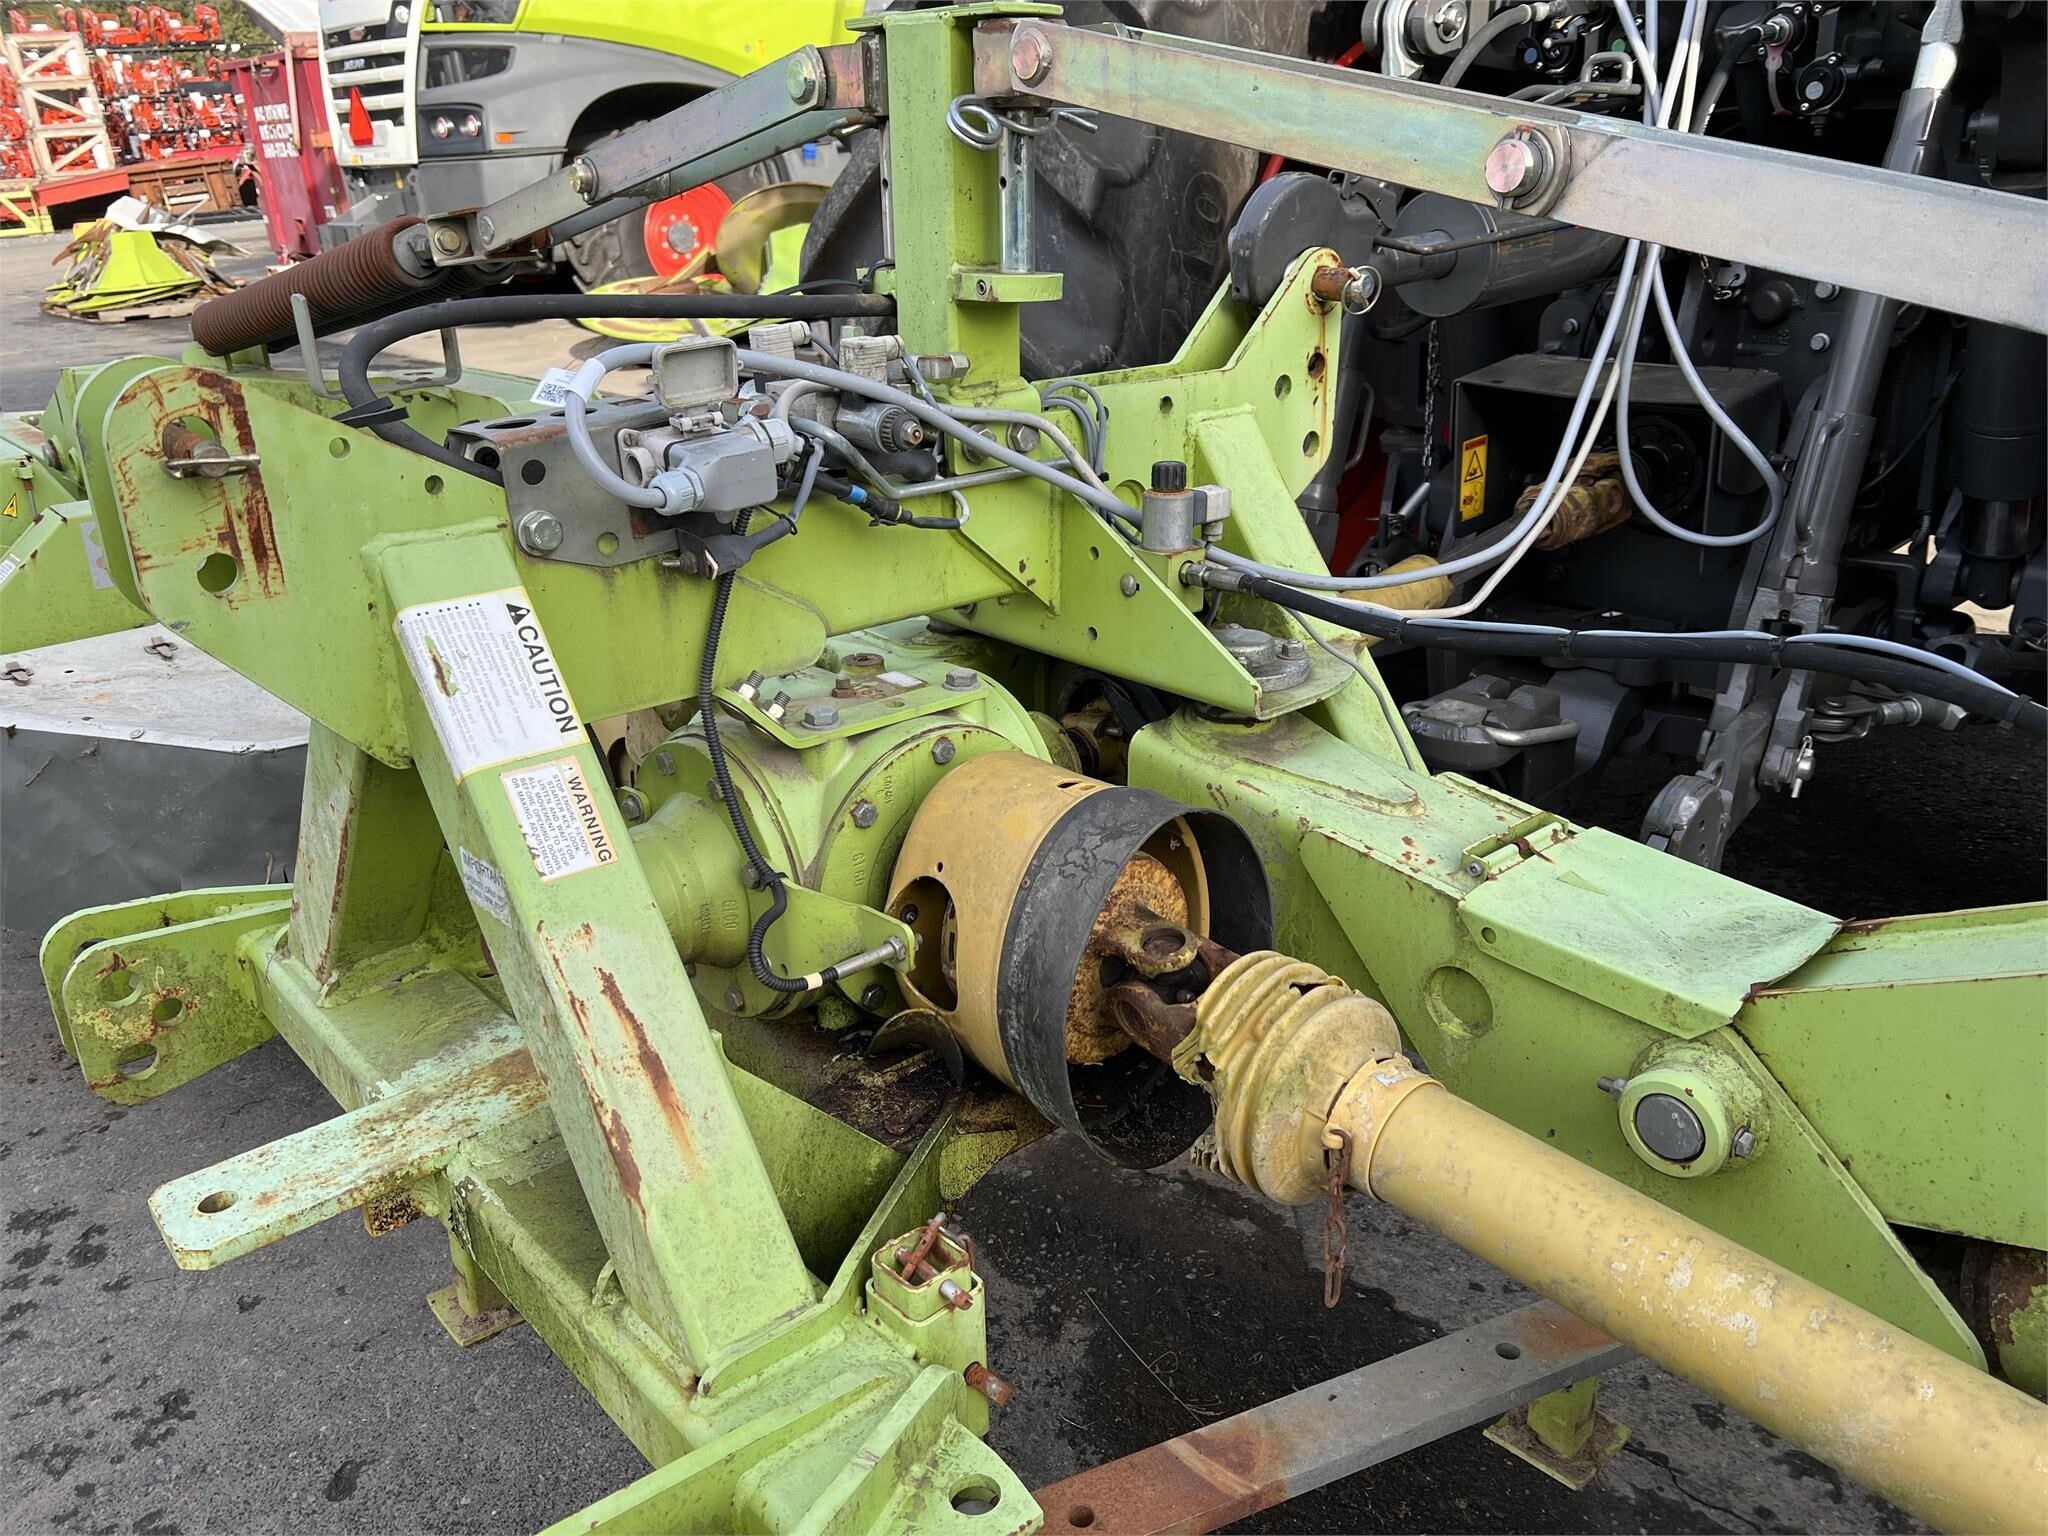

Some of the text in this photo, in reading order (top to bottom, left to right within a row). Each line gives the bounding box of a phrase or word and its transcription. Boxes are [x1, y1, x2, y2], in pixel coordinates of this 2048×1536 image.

[498, 632, 511, 651] FROM
[508, 639, 521, 657] AVOID
[516, 657, 534, 687] PERSONAL
[529, 687, 543, 709] INJURY
[515, 623, 579, 734] CAUTION
[510, 776, 556, 875] OR MAKING ADJUSTMENTS
[518, 776, 562, 871] BEFORE OPENING DOORS
[527, 775, 570, 867] ALL MOVEMENT TO STOP
[536, 778, 575, 860] LISTEN AND WAIT FOR
[545, 779, 564, 812] STARTER
[551, 773, 565, 793] STOP
[573, 825, 592, 858] REMOVE
[566, 775, 613, 862] WARNING
